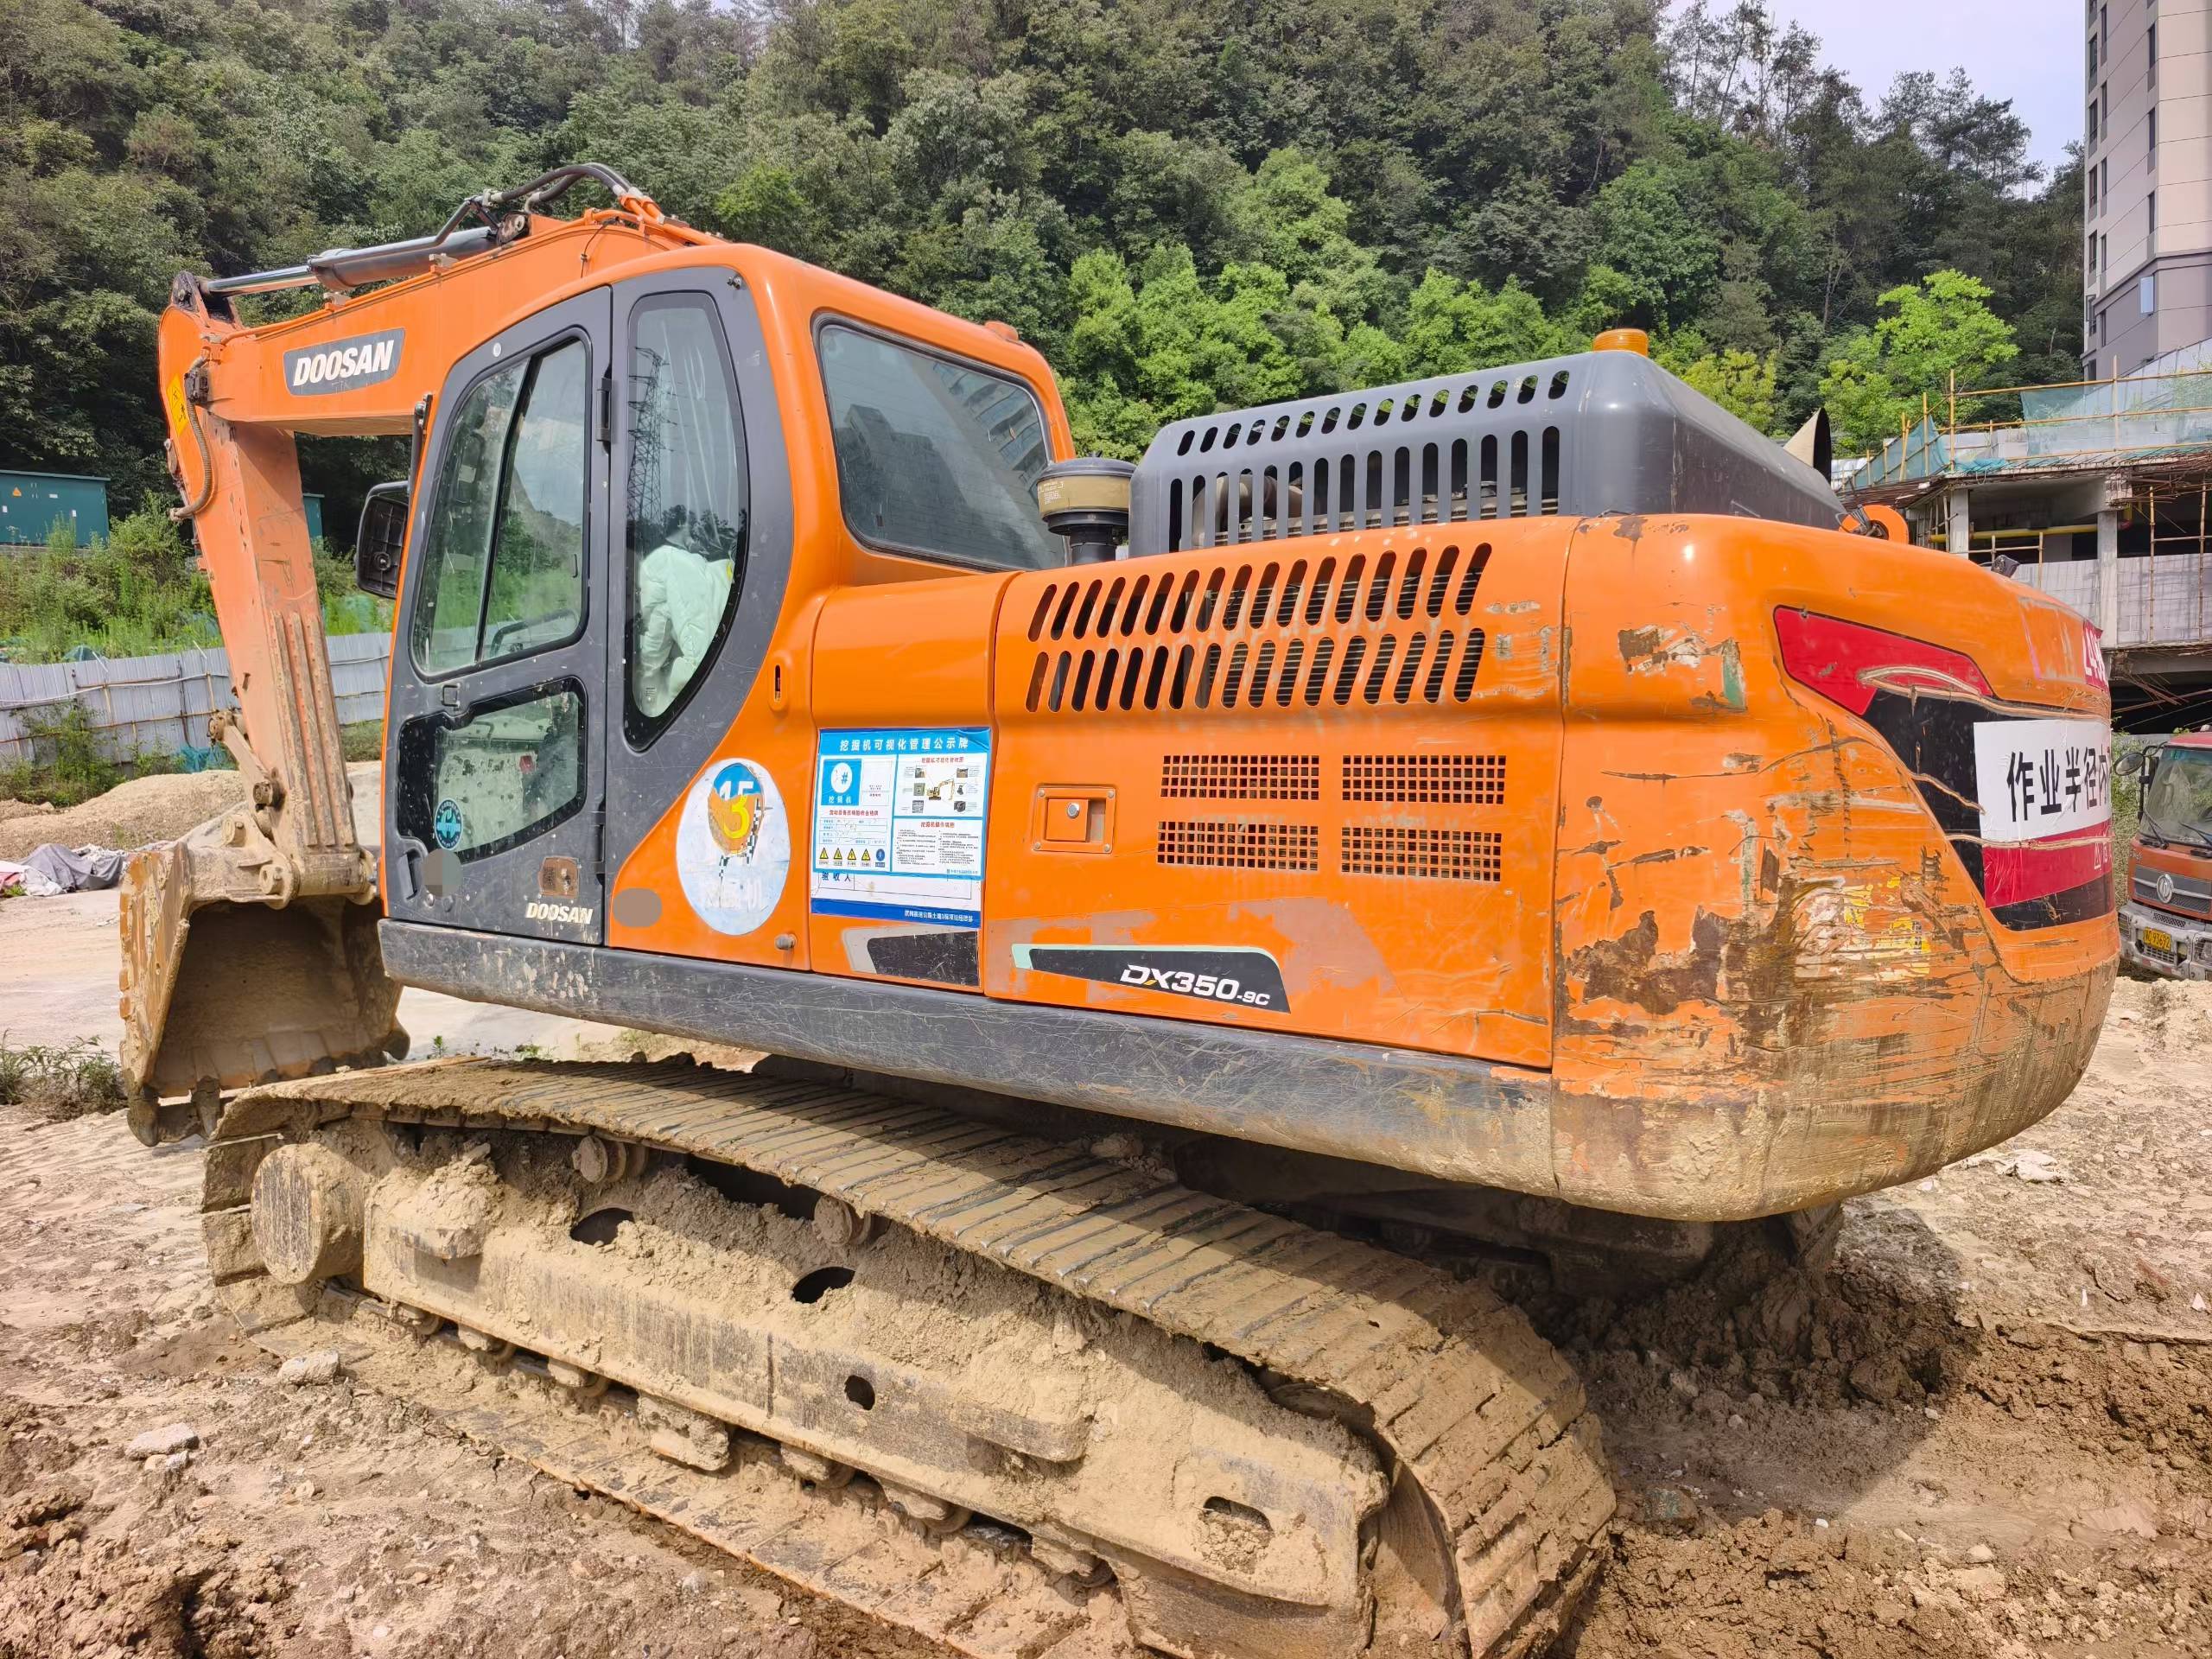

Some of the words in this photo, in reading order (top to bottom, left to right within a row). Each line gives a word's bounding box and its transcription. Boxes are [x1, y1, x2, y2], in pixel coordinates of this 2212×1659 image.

[293, 340, 394, 386] DOOSAN
[839, 737, 969, 752] 挖掘机可视化管理公示牌
[525, 902, 594, 925] DOOSAN
